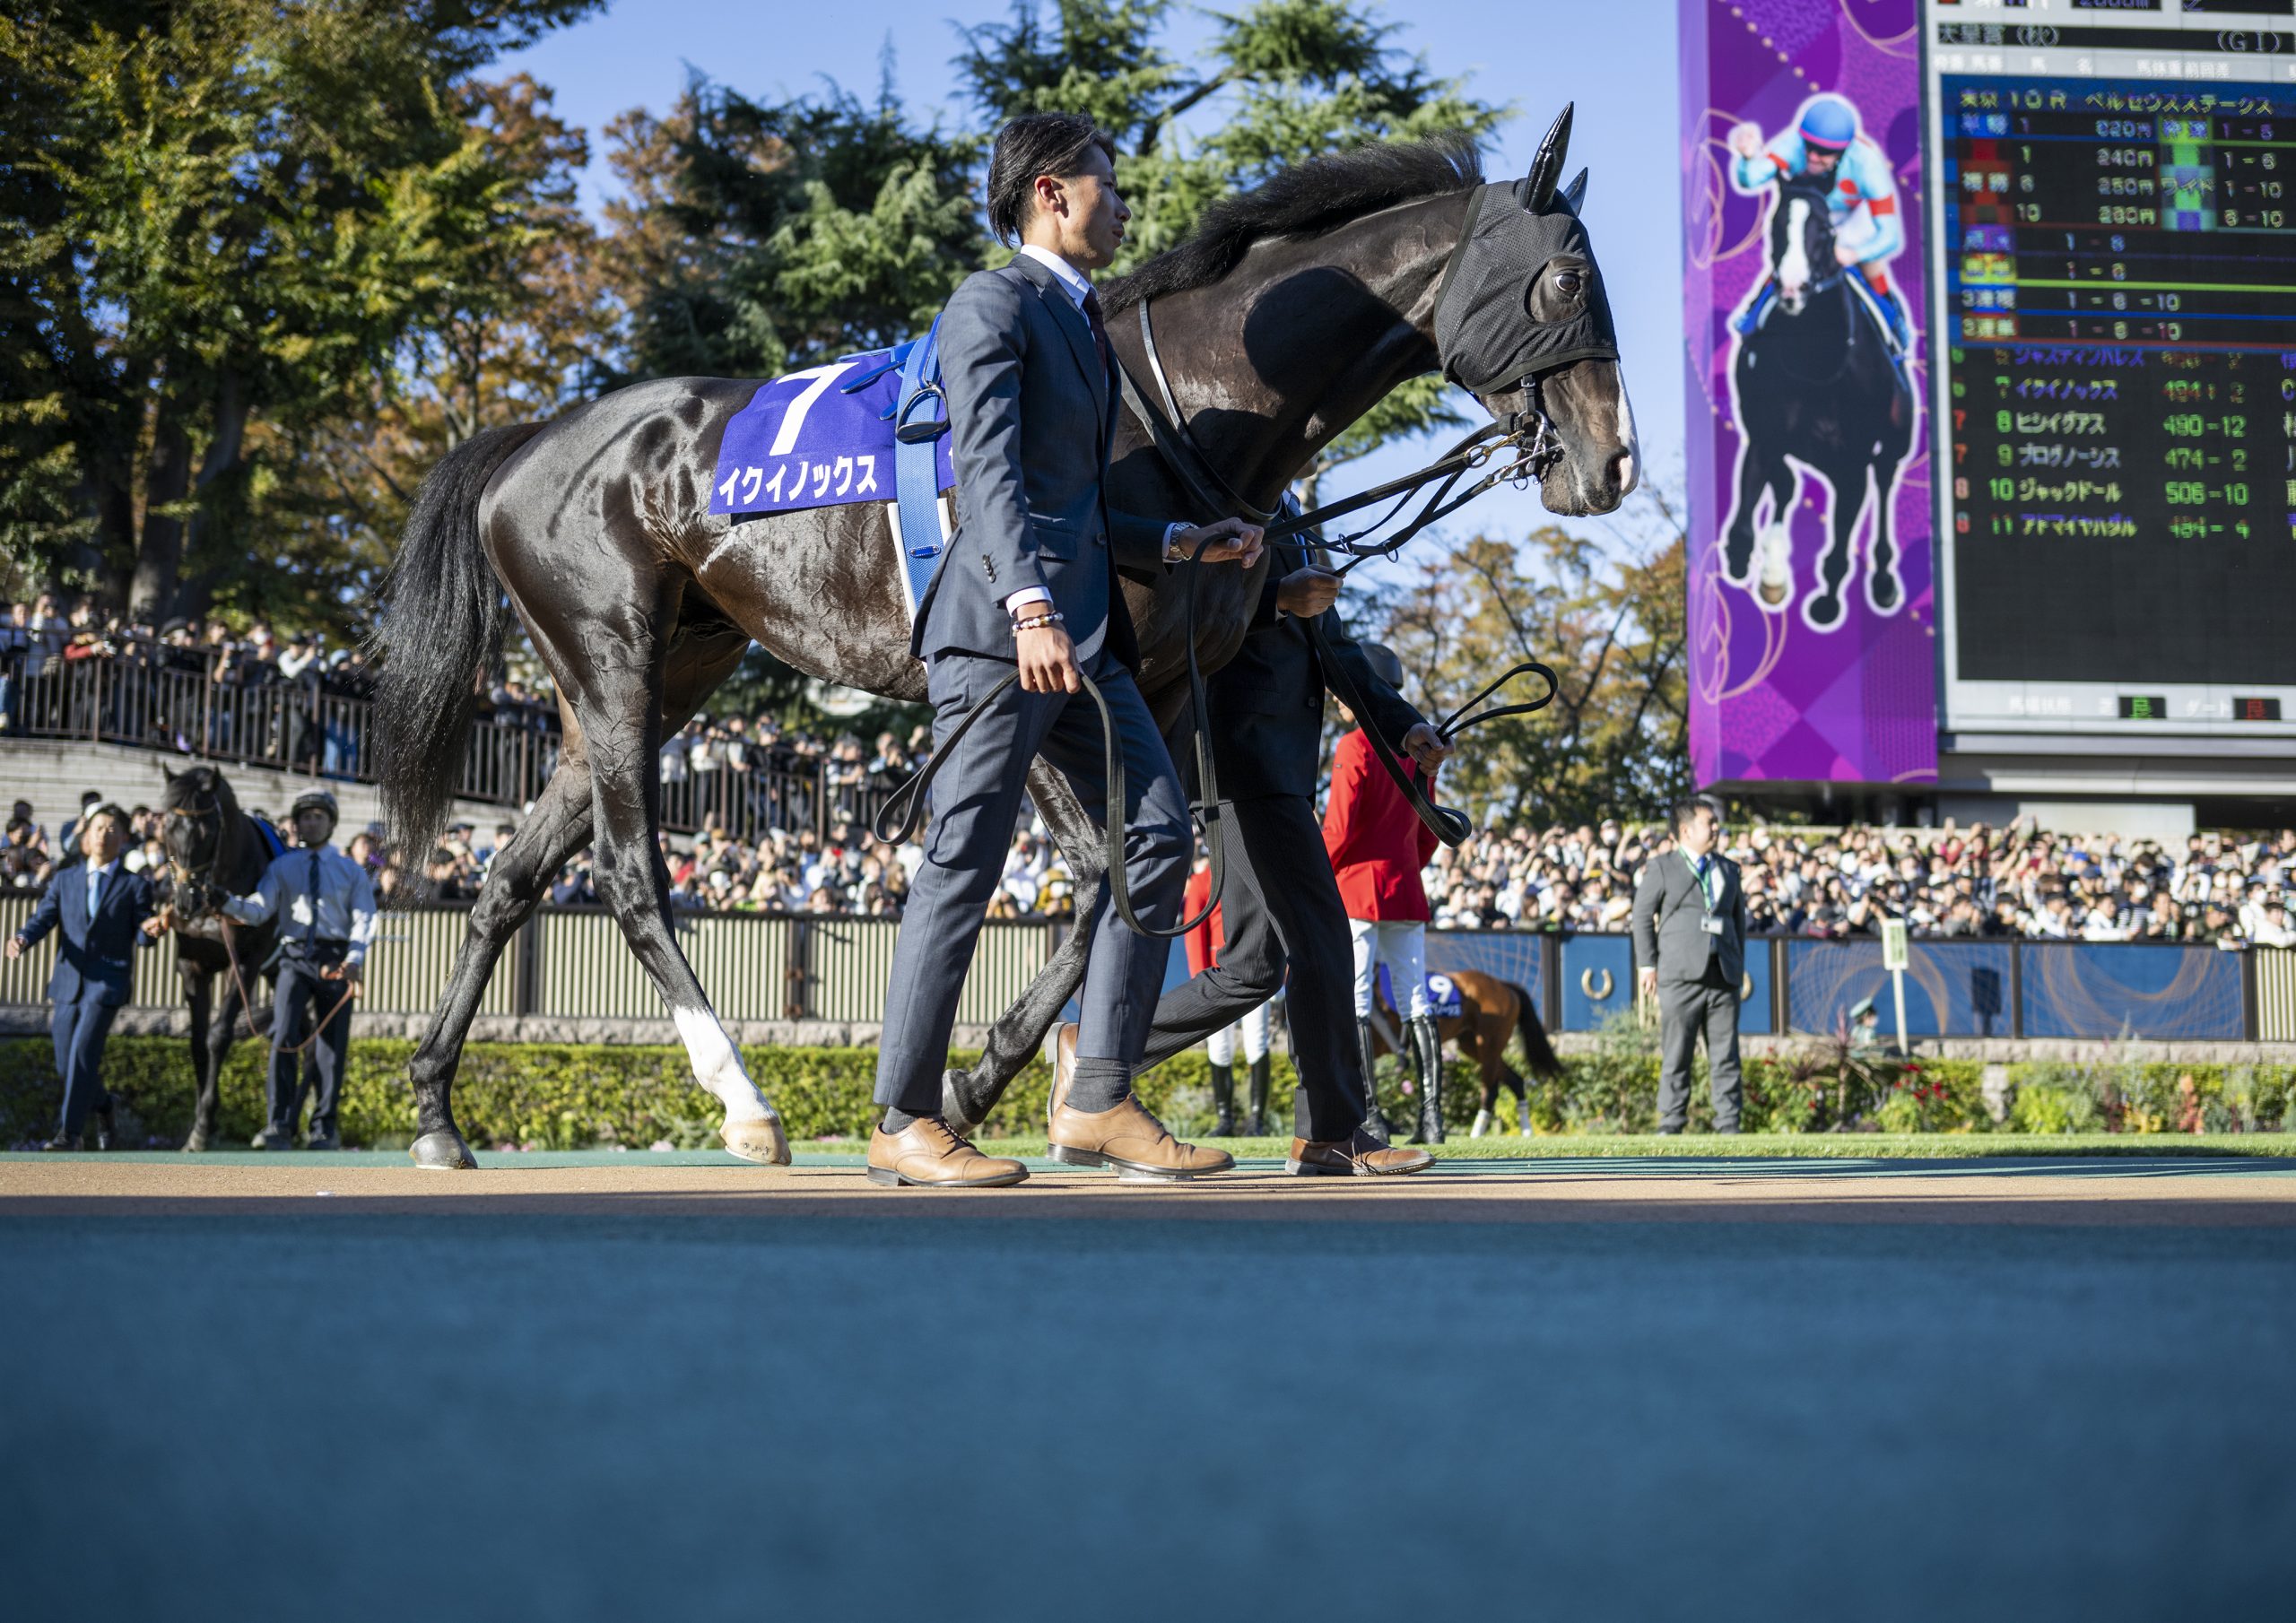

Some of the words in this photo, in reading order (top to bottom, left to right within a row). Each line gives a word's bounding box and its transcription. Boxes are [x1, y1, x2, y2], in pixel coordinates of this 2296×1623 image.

[770, 362, 860, 456] 7
[1952, 409, 1967, 431] 7
[1952, 443, 1968, 464] 7
[718, 455, 878, 507] イクイノックス
[1988, 477, 2014, 501] 10
[1428, 975, 1454, 1005] 9
